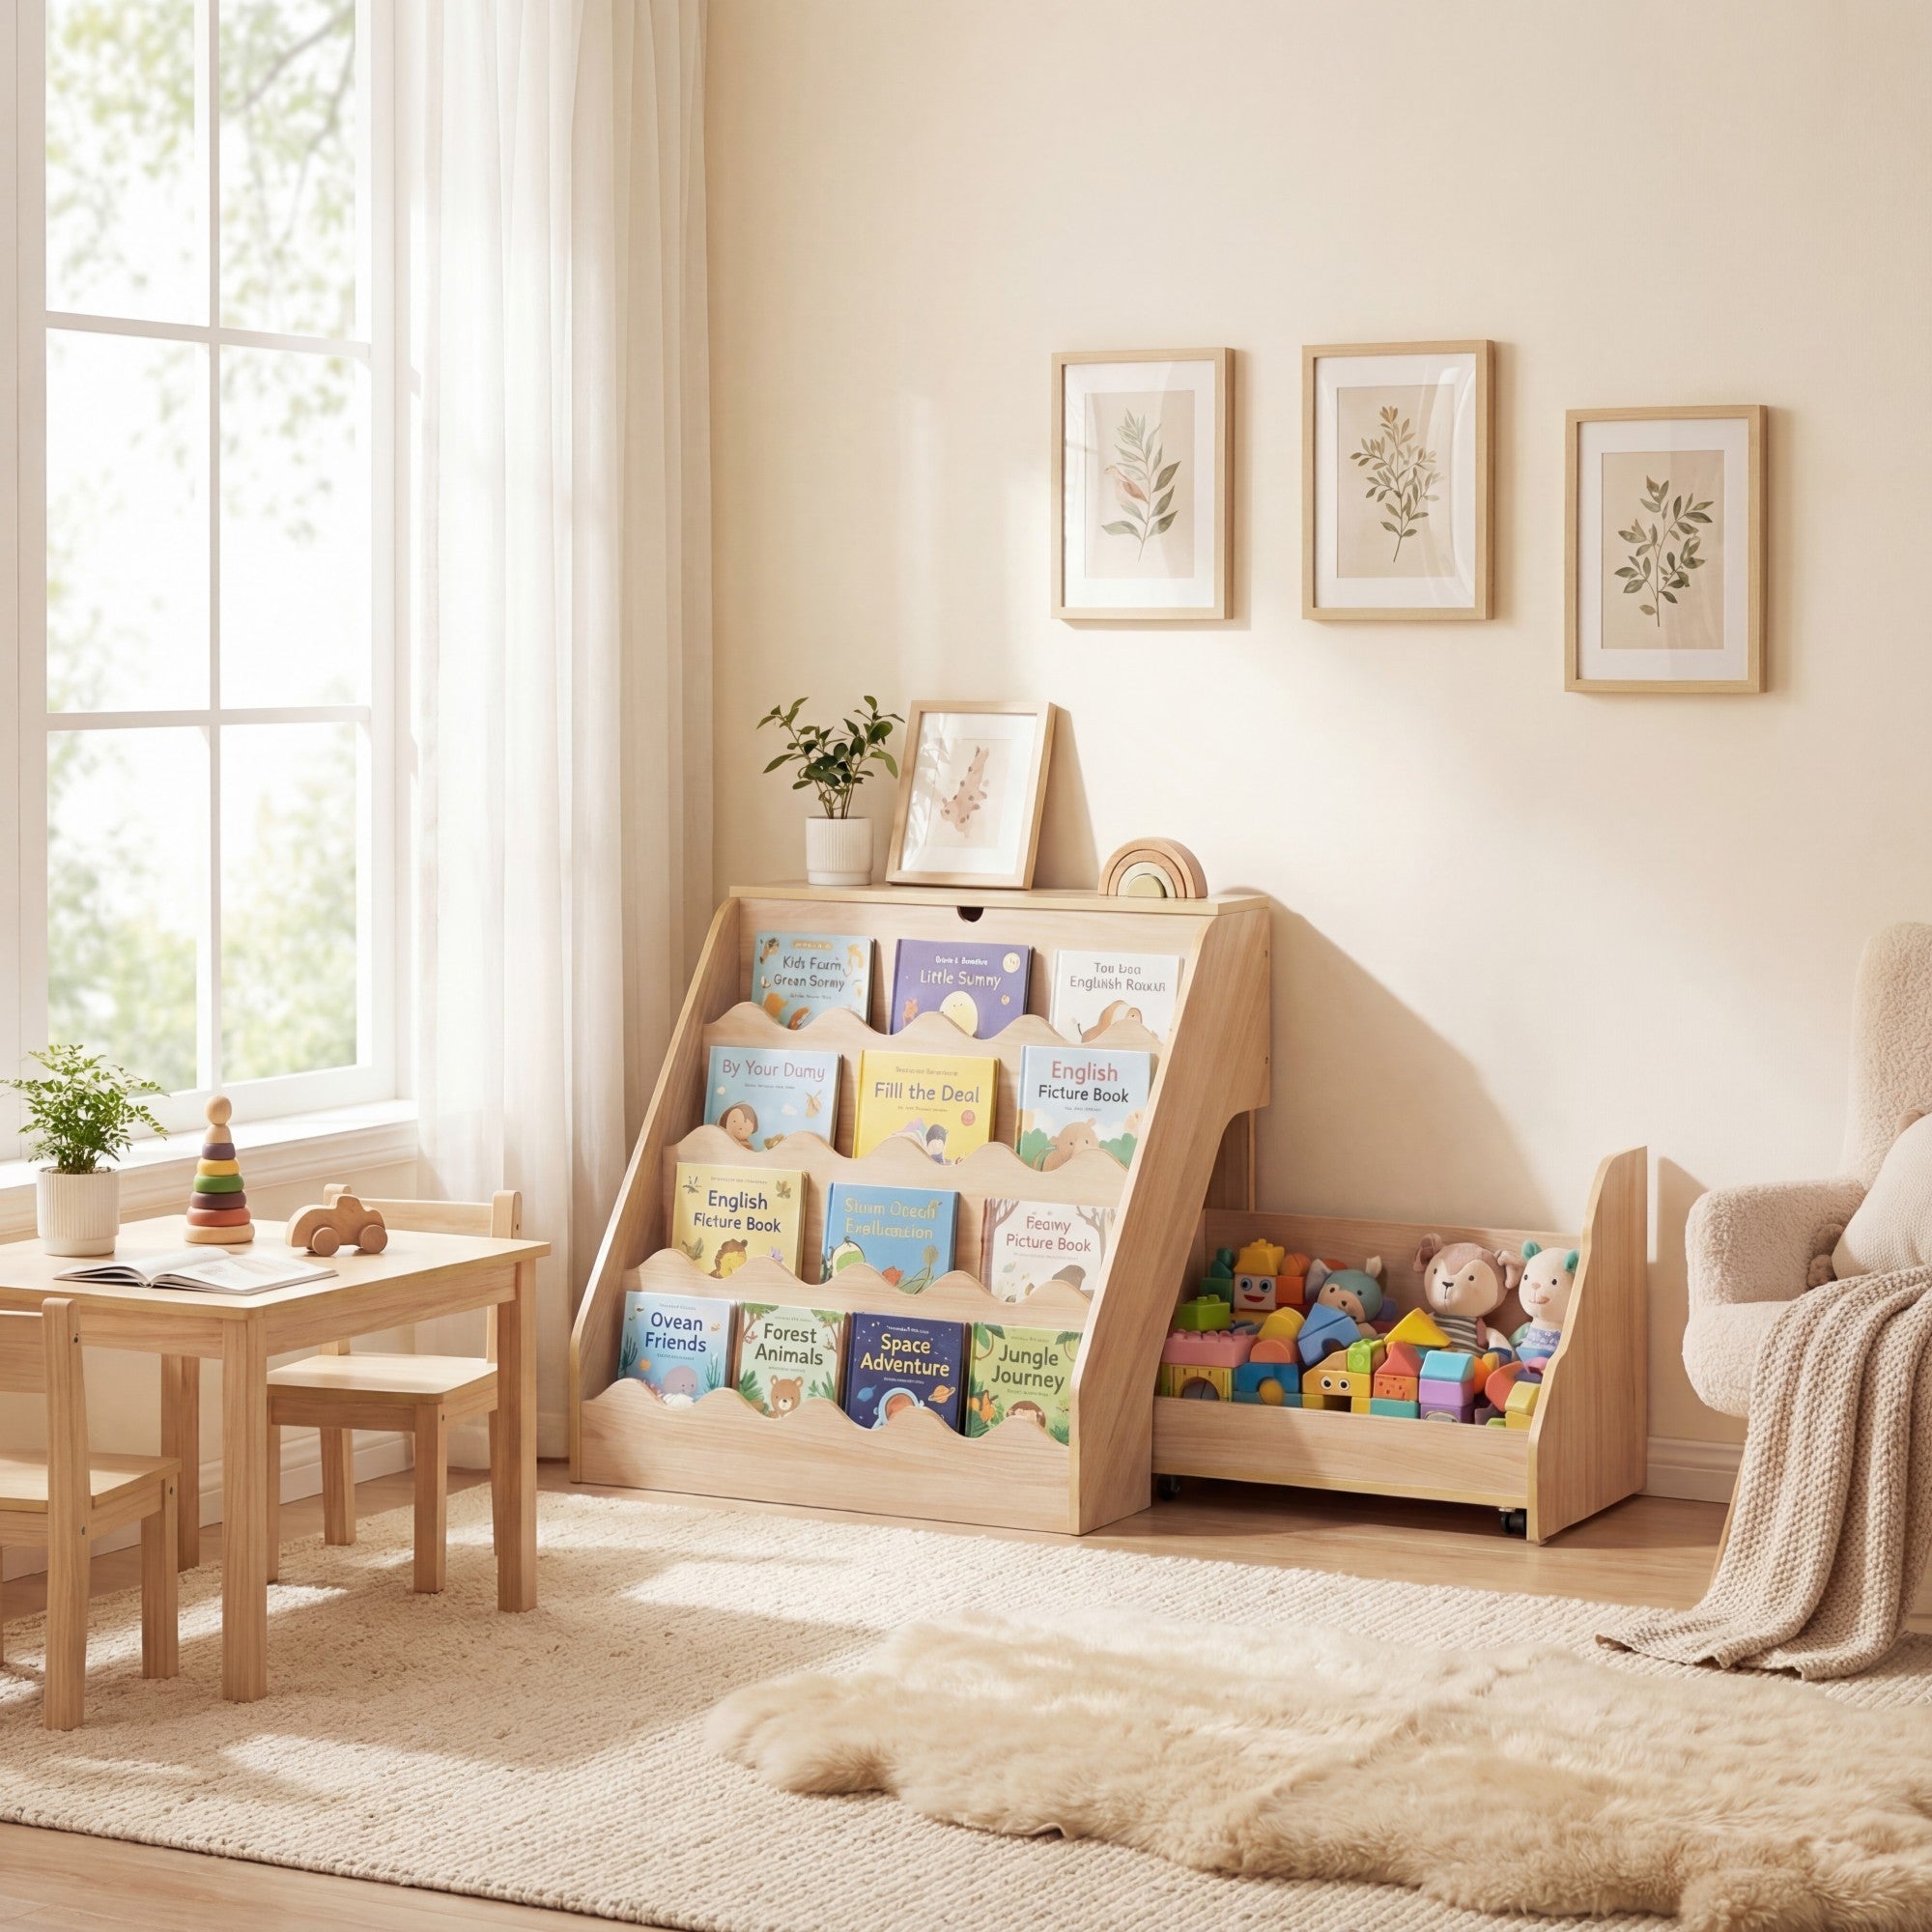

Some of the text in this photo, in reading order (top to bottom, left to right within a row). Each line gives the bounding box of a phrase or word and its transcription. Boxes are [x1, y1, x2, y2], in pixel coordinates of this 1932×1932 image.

[920, 969, 954, 984] Little
[723, 1059, 741, 1078] By
[746, 1060, 779, 1076] Your
[1051, 1061, 1118, 1085] English
[908, 1083, 935, 1100] the
[942, 1084, 980, 1103] Deal
[1038, 1084, 1129, 1103] Ficture Book
[708, 1189, 768, 1212] English
[746, 1216, 781, 1233] Book
[1006, 1233, 1092, 1252] Picture Book
[650, 1311, 703, 1332] Ovean
[645, 1331, 707, 1352] Friends
[764, 1322, 817, 1344] Forest
[754, 1343, 824, 1365] Animals
[880, 1333, 931, 1356] Space
[860, 1351, 951, 1378] Adventure
[998, 1344, 1059, 1370] Jungle
[991, 1365, 1065, 1395] Journey
